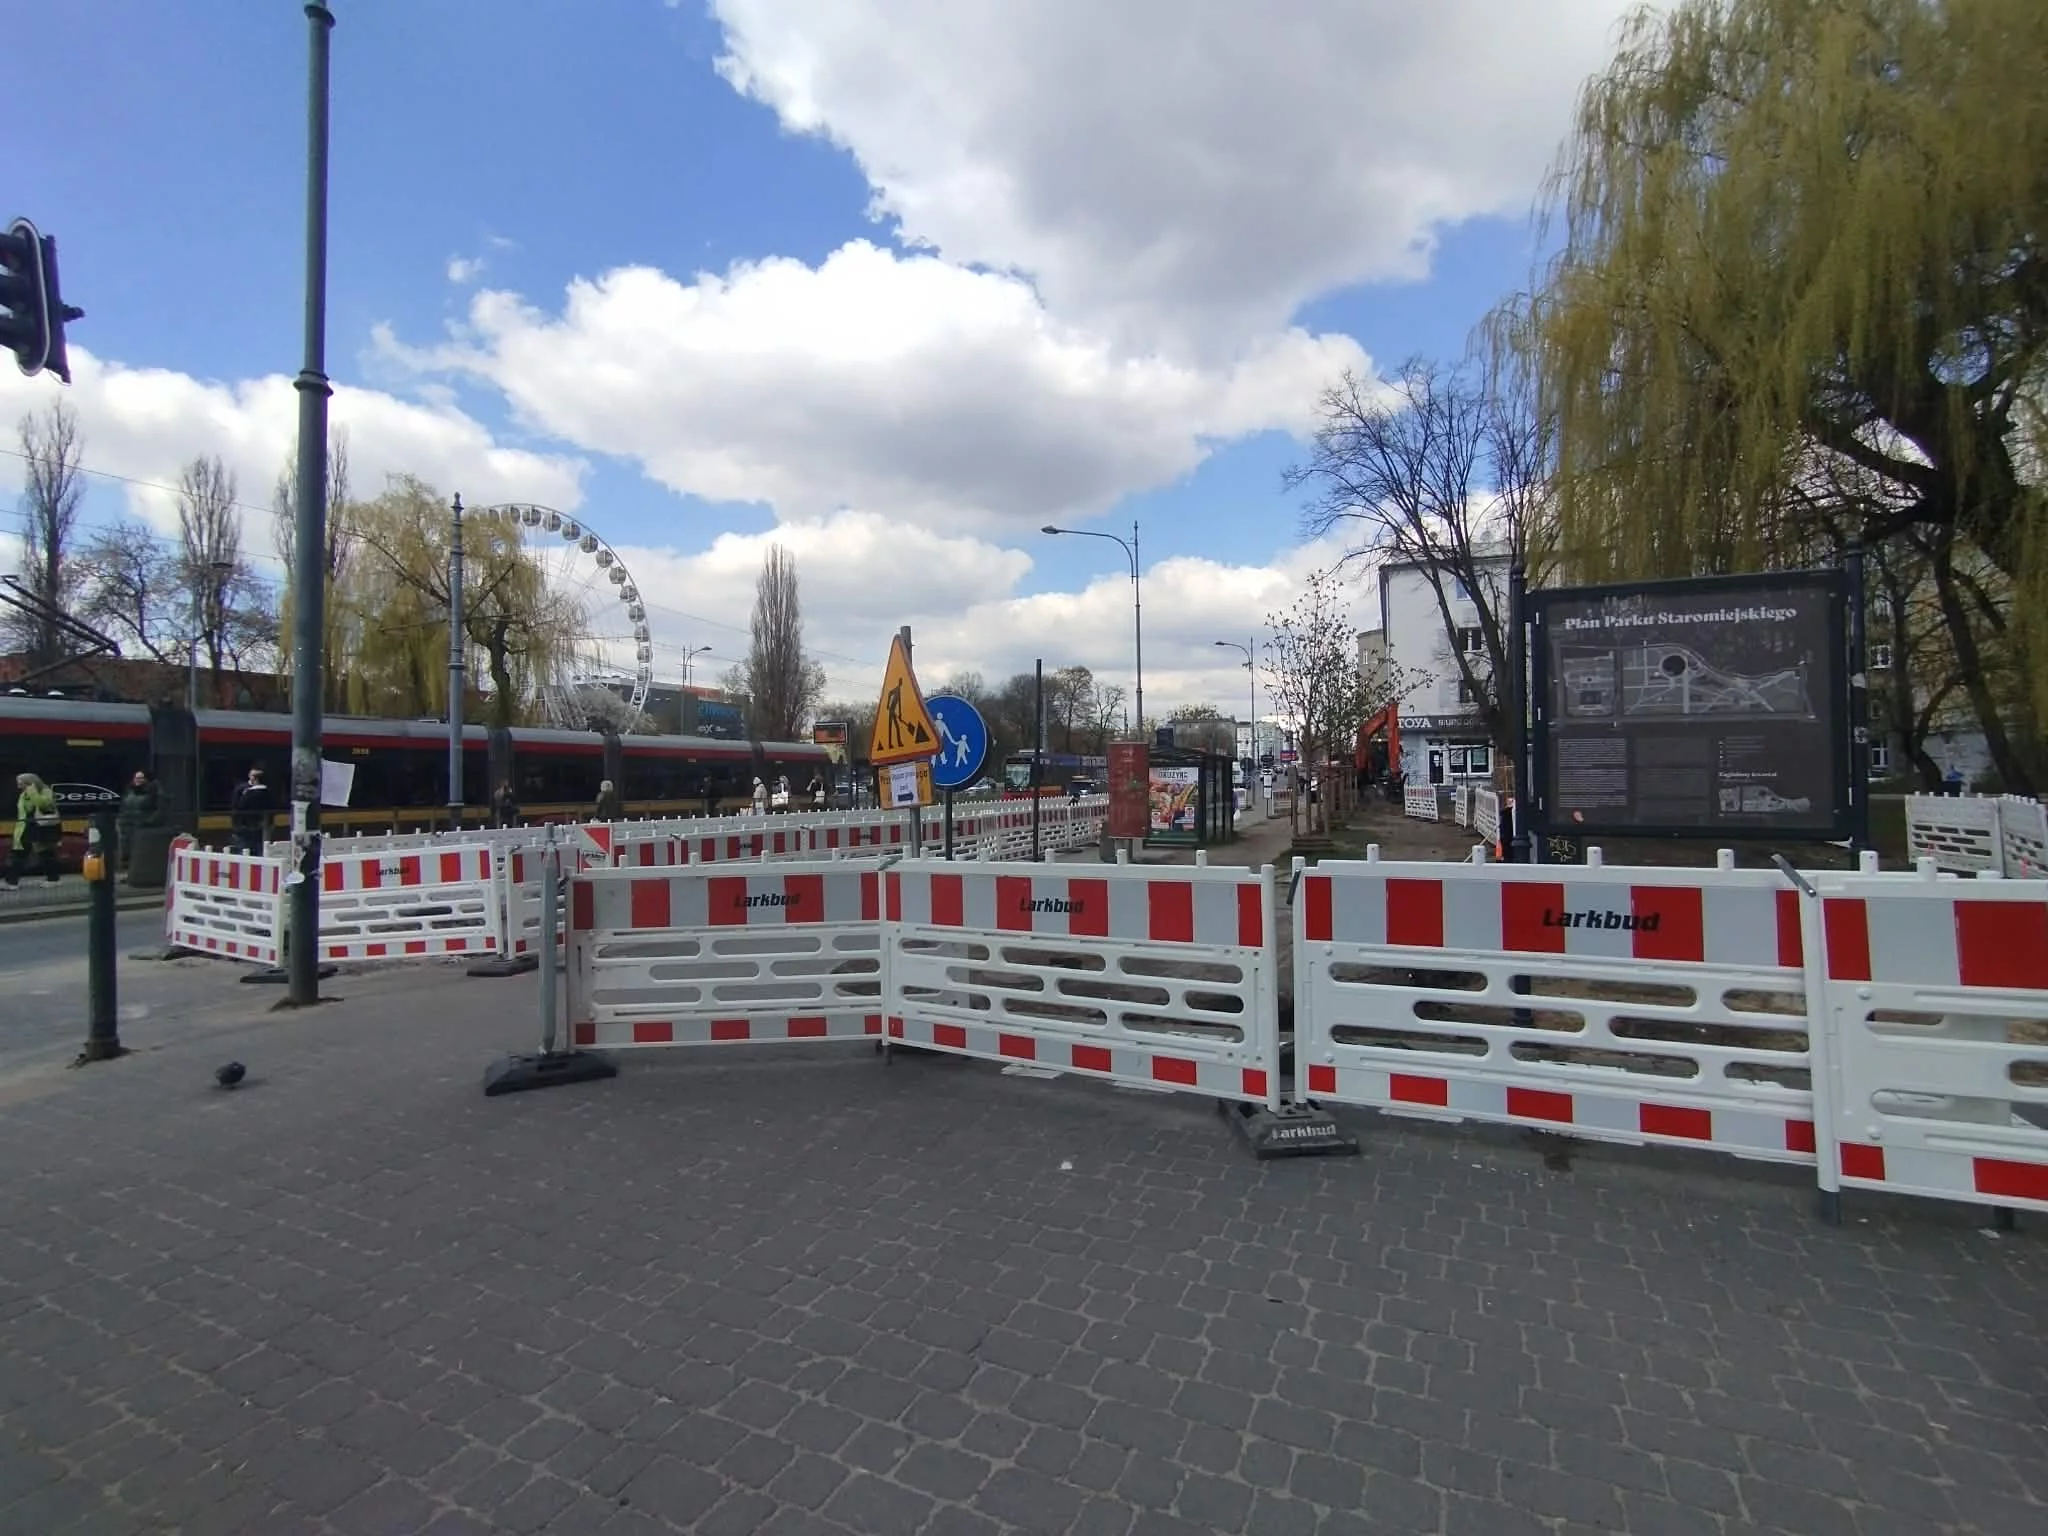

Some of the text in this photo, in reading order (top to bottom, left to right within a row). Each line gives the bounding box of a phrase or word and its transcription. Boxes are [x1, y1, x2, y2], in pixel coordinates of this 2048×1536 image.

[1564, 606, 1797, 630] Plan Parku Staromiejskiego
[1396, 717, 1432, 729] TOYA
[733, 892, 801, 908] Larkbud
[1019, 897, 1084, 913] Larkbud
[1542, 908, 1660, 931] Larkbud
[1271, 1124, 1337, 1140] Larkbud
